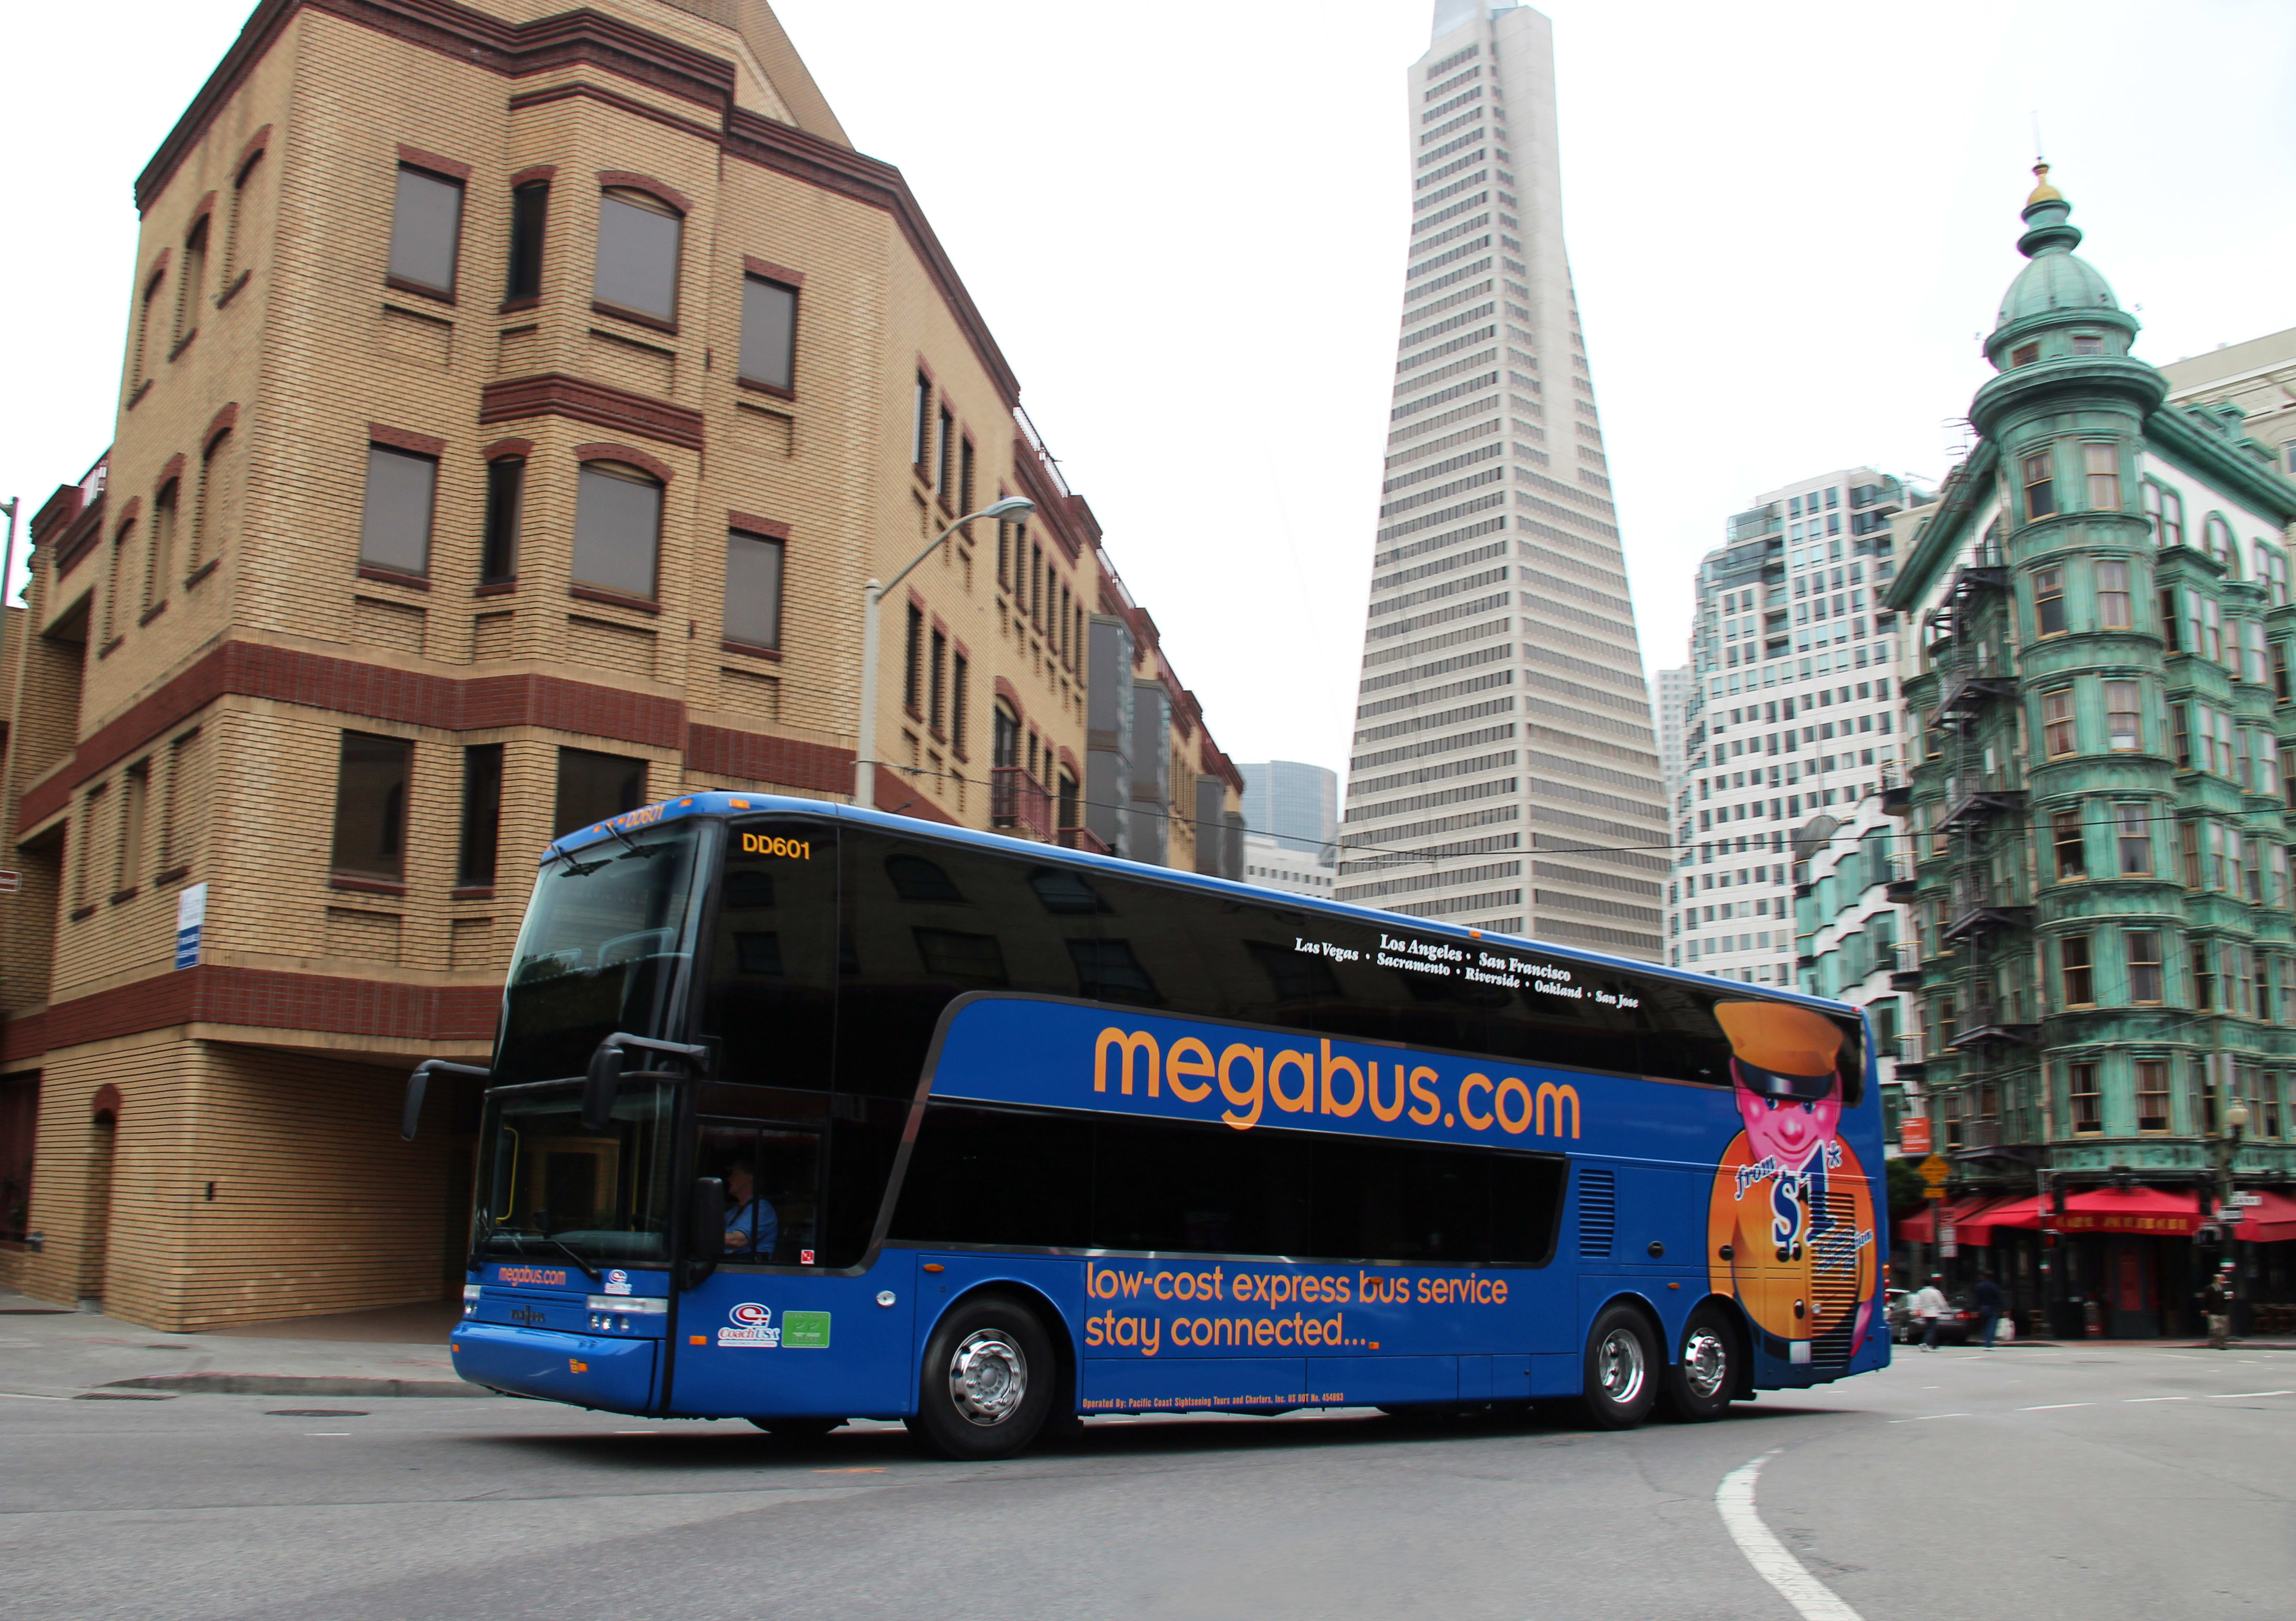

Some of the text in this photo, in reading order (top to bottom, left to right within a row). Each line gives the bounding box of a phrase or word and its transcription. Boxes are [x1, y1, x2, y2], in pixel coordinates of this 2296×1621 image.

[625, 804, 665, 827] DD601
[742, 833, 809, 860] DD601
[1295, 937, 1639, 1009] Las Vegas Sacramento Riverside Oakland San Jose
[1379, 933, 1572, 982] Los Angeles San Francisco
[1094, 1027, 1580, 1139] megabus.com
[1734, 1154, 1776, 1201] from
[499, 1266, 566, 1287] megabus.com
[1087, 1262, 1508, 1310] low-cost express bus service
[1085, 1310, 1160, 1356] stay
[1083, 1393, 1343, 1409] Operated By: Pacific Coast Sightseeing Tours and Charters, Inc. US DOT No. 454893
